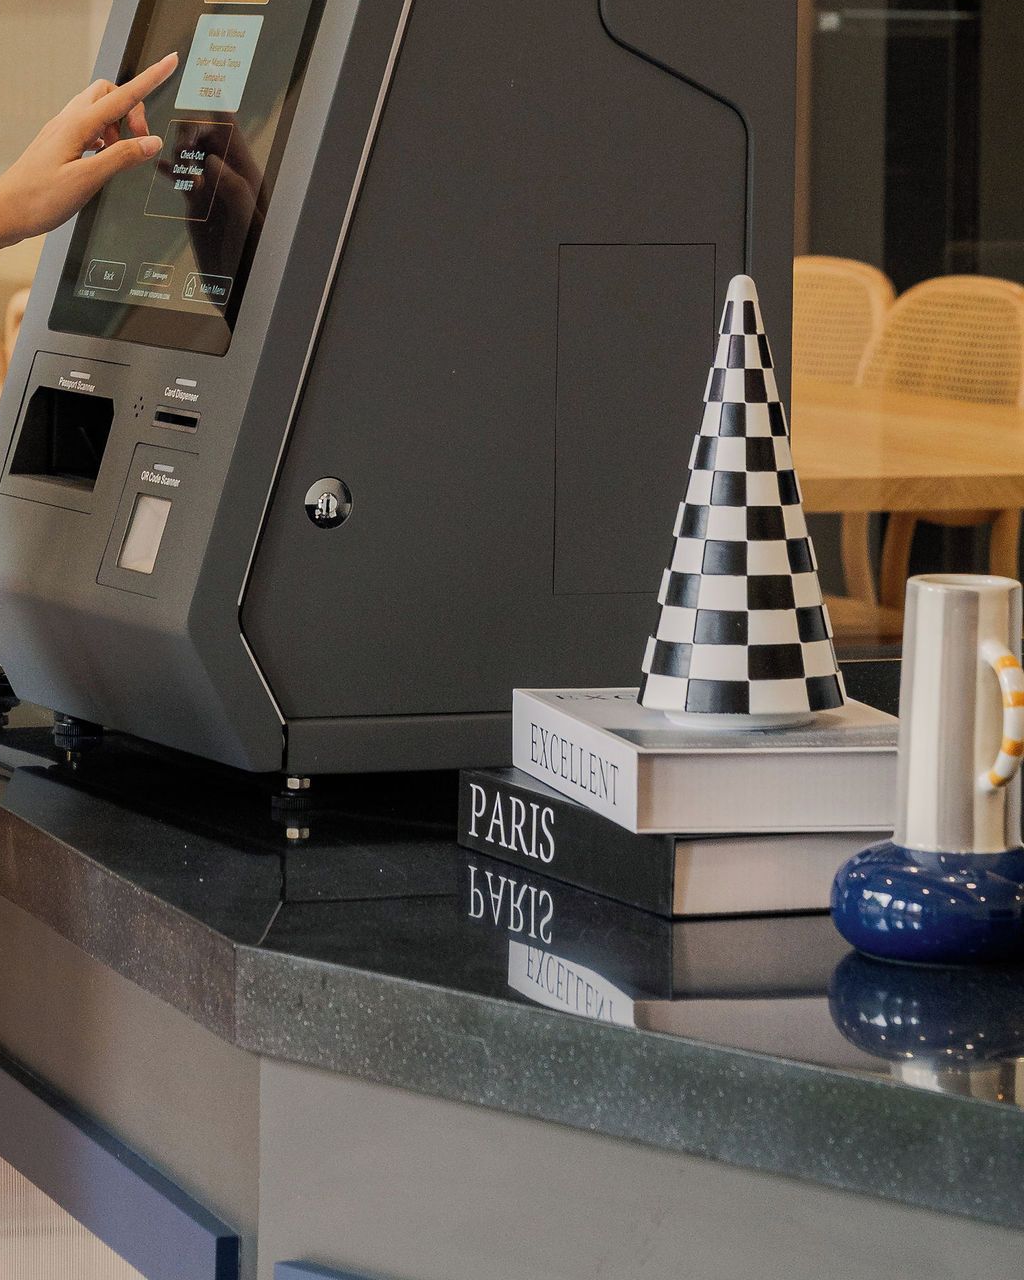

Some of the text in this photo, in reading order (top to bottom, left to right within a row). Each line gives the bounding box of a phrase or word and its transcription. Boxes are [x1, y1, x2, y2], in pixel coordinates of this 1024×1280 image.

[180, 150, 205, 160] Check-Out
[103, 270, 115, 281] Back
[200, 283, 226, 296] Main Menu
[58, 377, 96, 393] Passport Scanner
[164, 387, 199, 402] Card Dispenser
[141, 470, 181, 487] QR Code Scanner
[529, 722, 619, 806] EXCELLENT
[468, 783, 556, 864] PARIS
